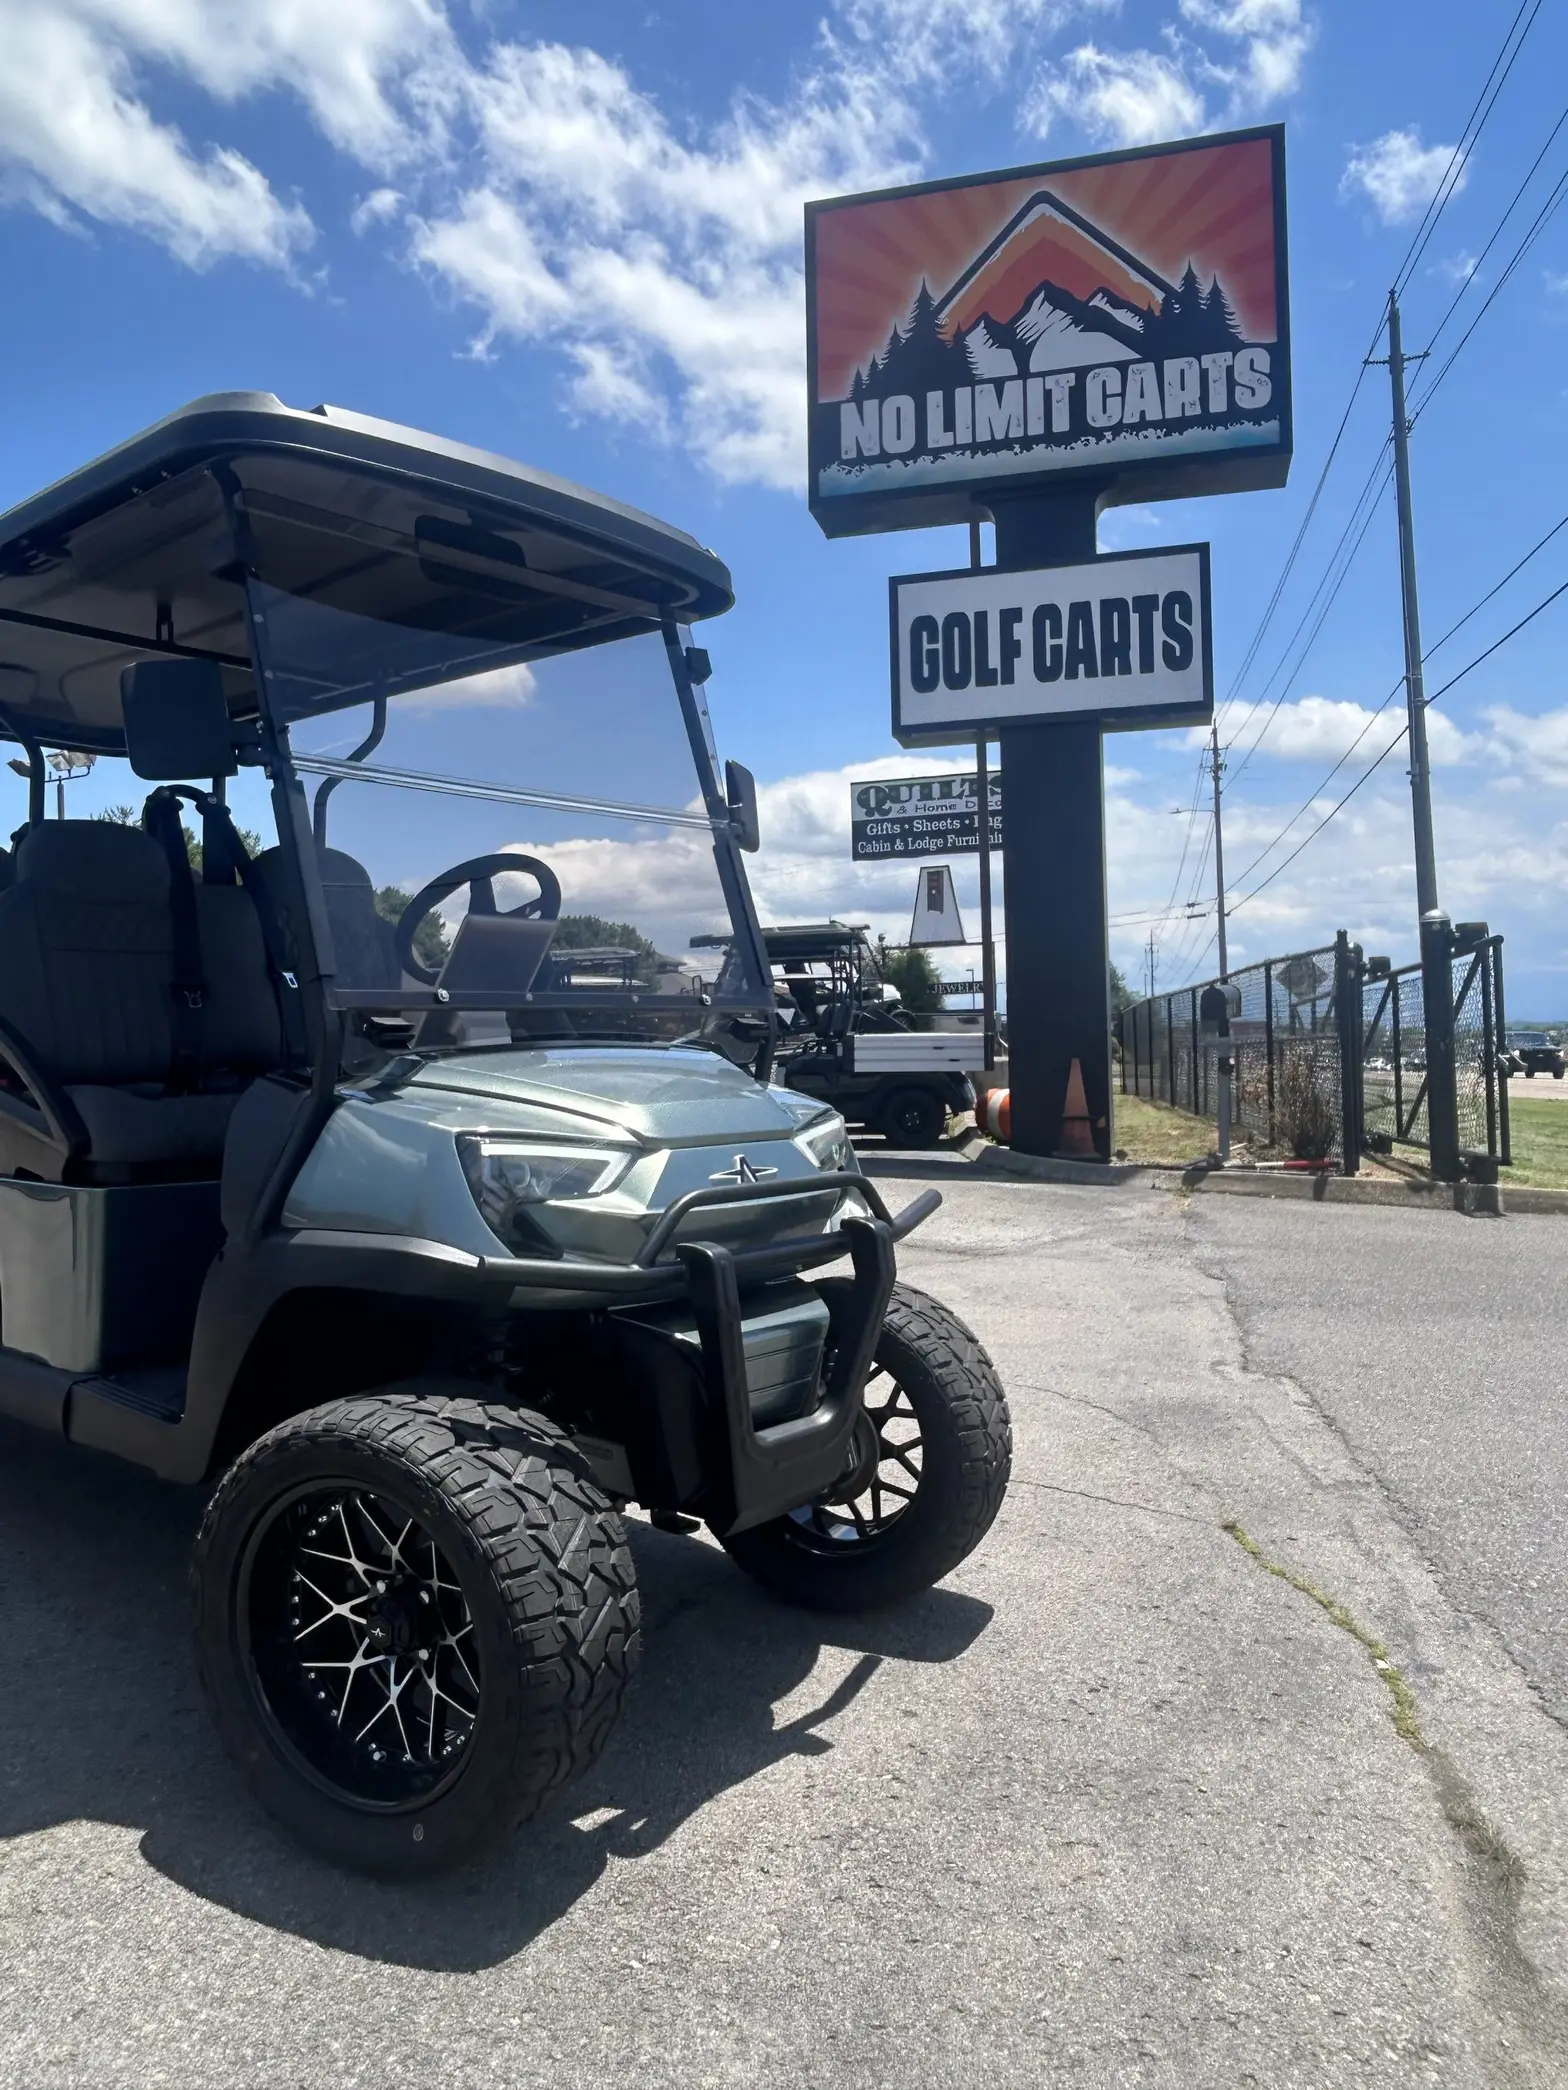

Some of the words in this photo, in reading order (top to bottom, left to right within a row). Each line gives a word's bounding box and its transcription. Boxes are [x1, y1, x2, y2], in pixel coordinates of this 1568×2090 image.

[840, 395, 915, 459] NO
[926, 373, 1075, 448] LIMIT
[1086, 347, 1272, 428] CARTS
[910, 607, 1023, 693] GOLF
[1032, 590, 1193, 683] CARTS
[858, 840, 891, 854] Cabin
[895, 839, 904, 851] &
[908, 835, 943, 851] Lodge
[867, 822, 900, 836] Gifts
[913, 818, 960, 832] Sheets
